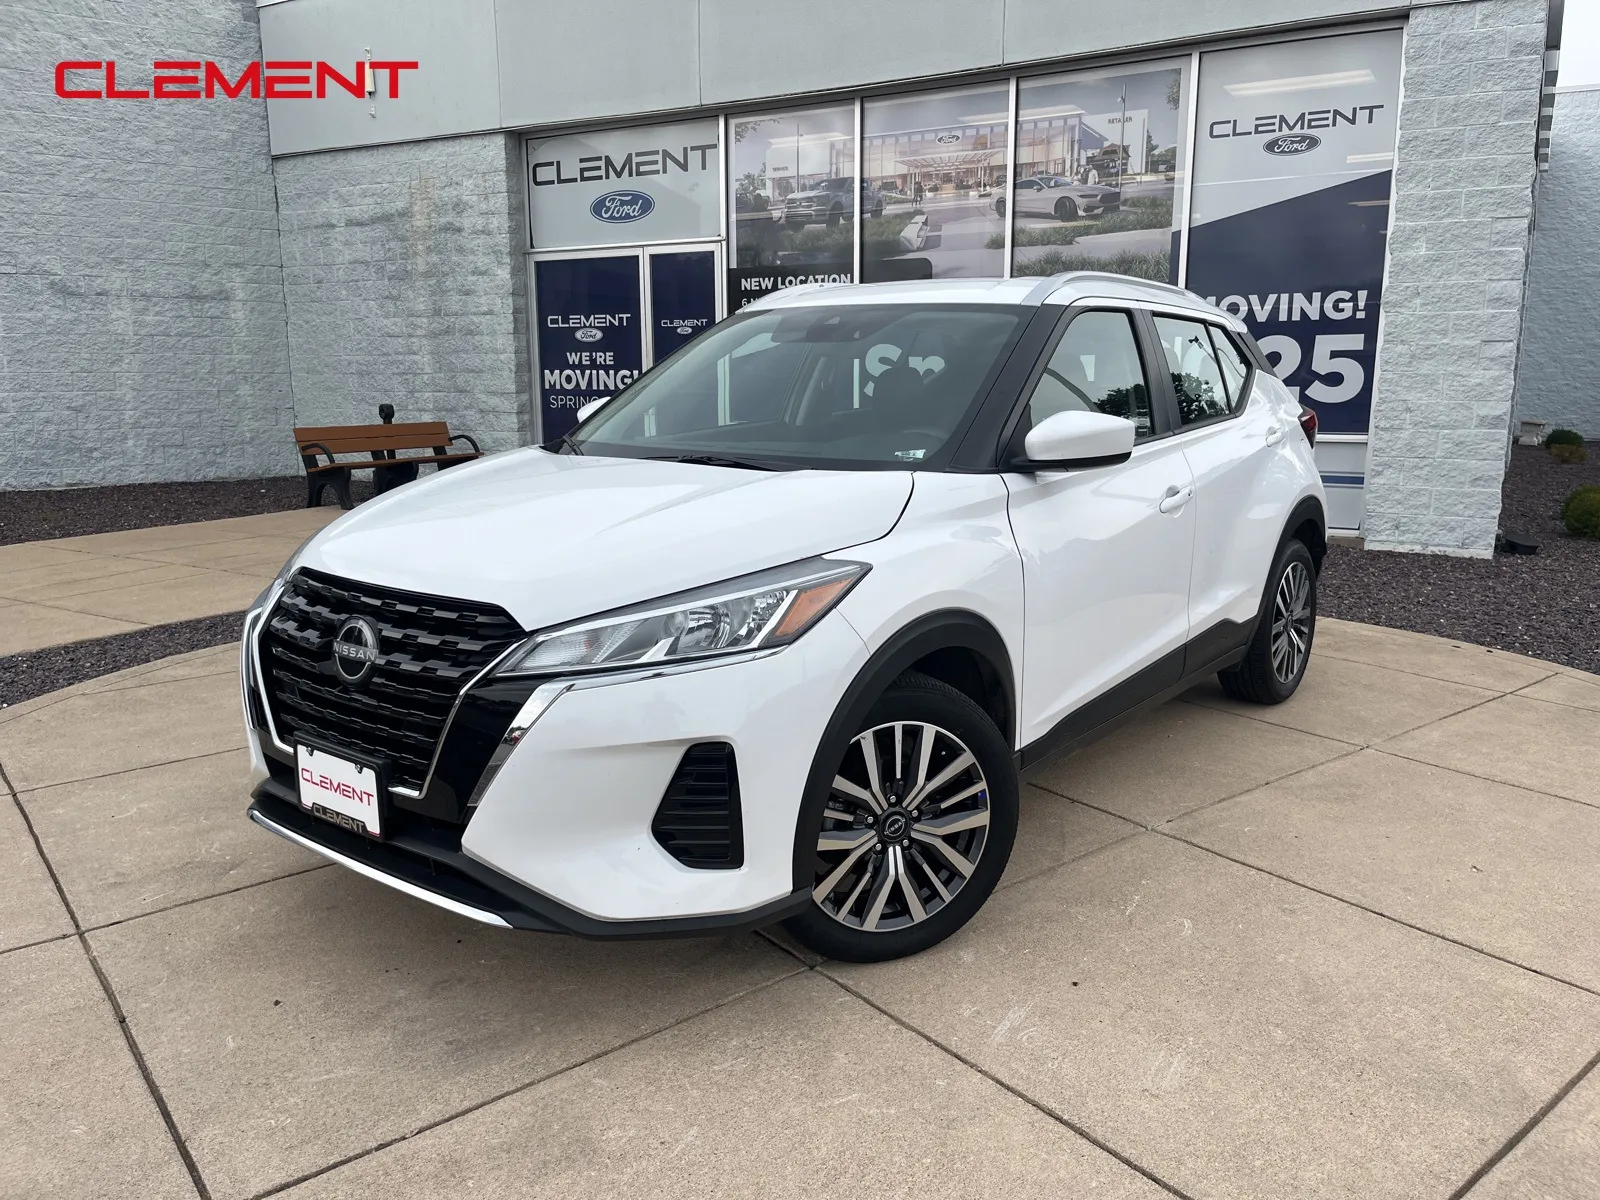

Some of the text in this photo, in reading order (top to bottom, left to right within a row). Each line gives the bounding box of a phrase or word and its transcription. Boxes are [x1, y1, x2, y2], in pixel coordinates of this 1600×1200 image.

[1209, 104, 1384, 139] CLEMENT
[1273, 136, 1310, 153] Ford
[532, 143, 717, 187] CLEMENT
[600, 194, 643, 219] Ford
[741, 274, 851, 291] NEW LOCATION
[1206, 290, 1368, 322] OVING!
[547, 314, 631, 328] CLEMENT
[661, 319, 708, 327] CLEMENT
[566, 352, 615, 365] WE'RE
[1257, 334, 1365, 404] 25
[333, 642, 376, 661] NISSAN
[301, 767, 374, 806] CLEMENT
[313, 803, 364, 833] CLEMENT
